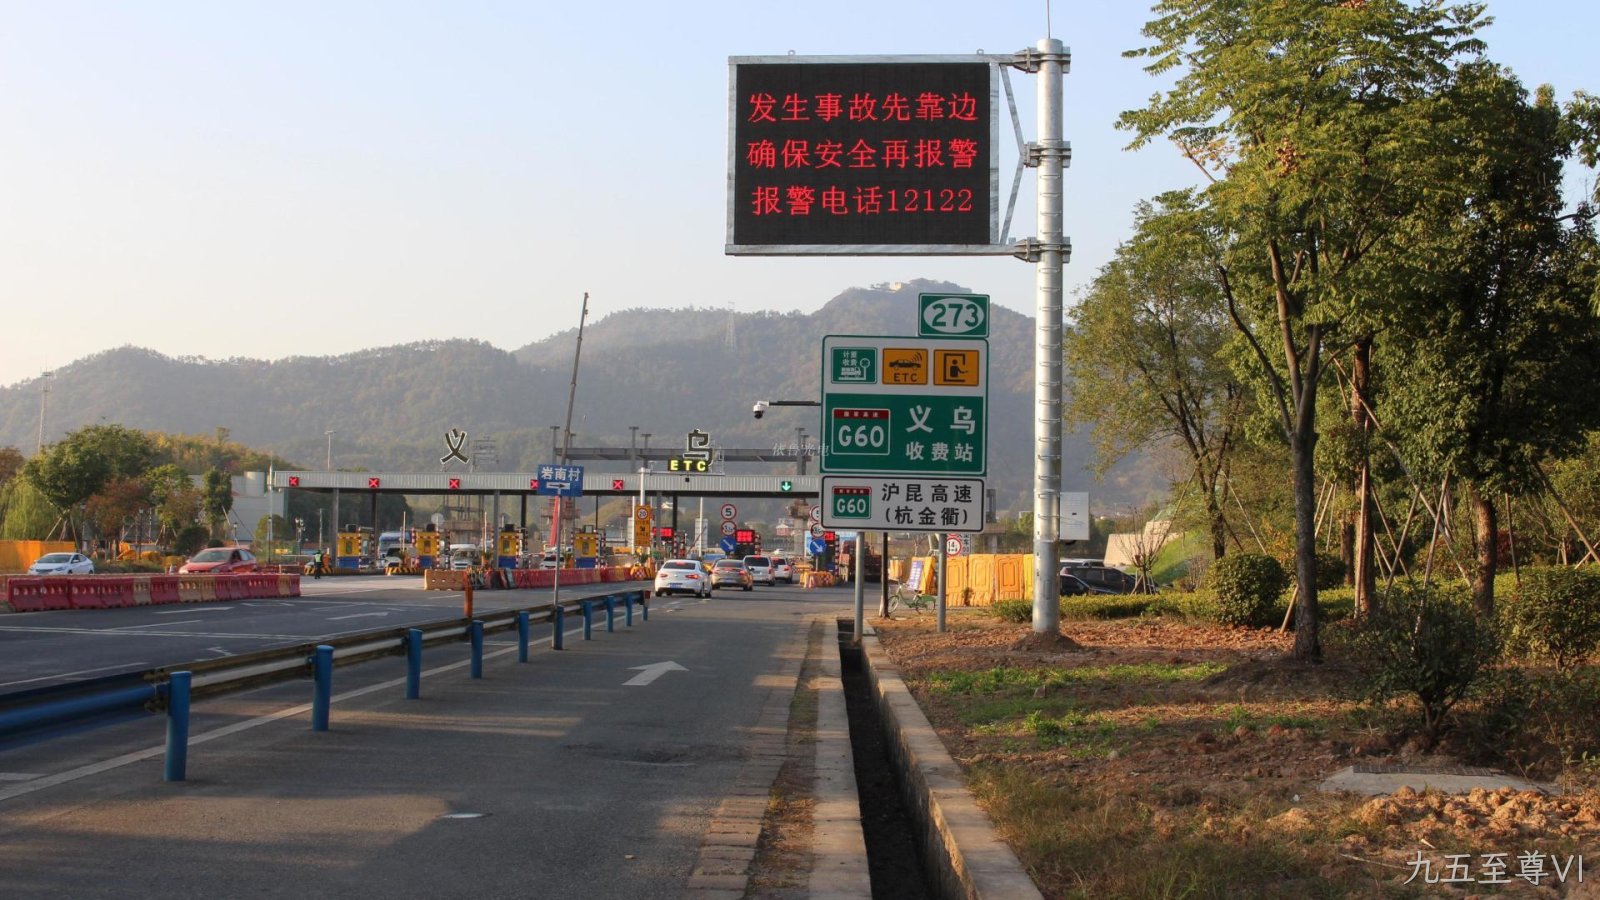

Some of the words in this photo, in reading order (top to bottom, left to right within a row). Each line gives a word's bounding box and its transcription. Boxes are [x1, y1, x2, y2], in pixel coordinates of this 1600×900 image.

[747, 92, 979, 122] 发生事故先靠边
[746, 138, 977, 169] 确保安全再报警
[752, 186, 973, 216] 报警电话12122
[931, 303, 979, 327] 273
[893, 373, 918, 382] ETC
[905, 404, 975, 435] 义乌
[440, 428, 469, 464] 义
[838, 425, 884, 447] G60
[905, 442, 973, 462] 收费站
[541, 466, 581, 481] 岩南村
[669, 459, 707, 471] ETC
[881, 483, 972, 503] 沪昆高速
[725, 507, 732, 516] 5
[836, 498, 867, 514] G60
[885, 506, 968, 526] (杭金衢)
